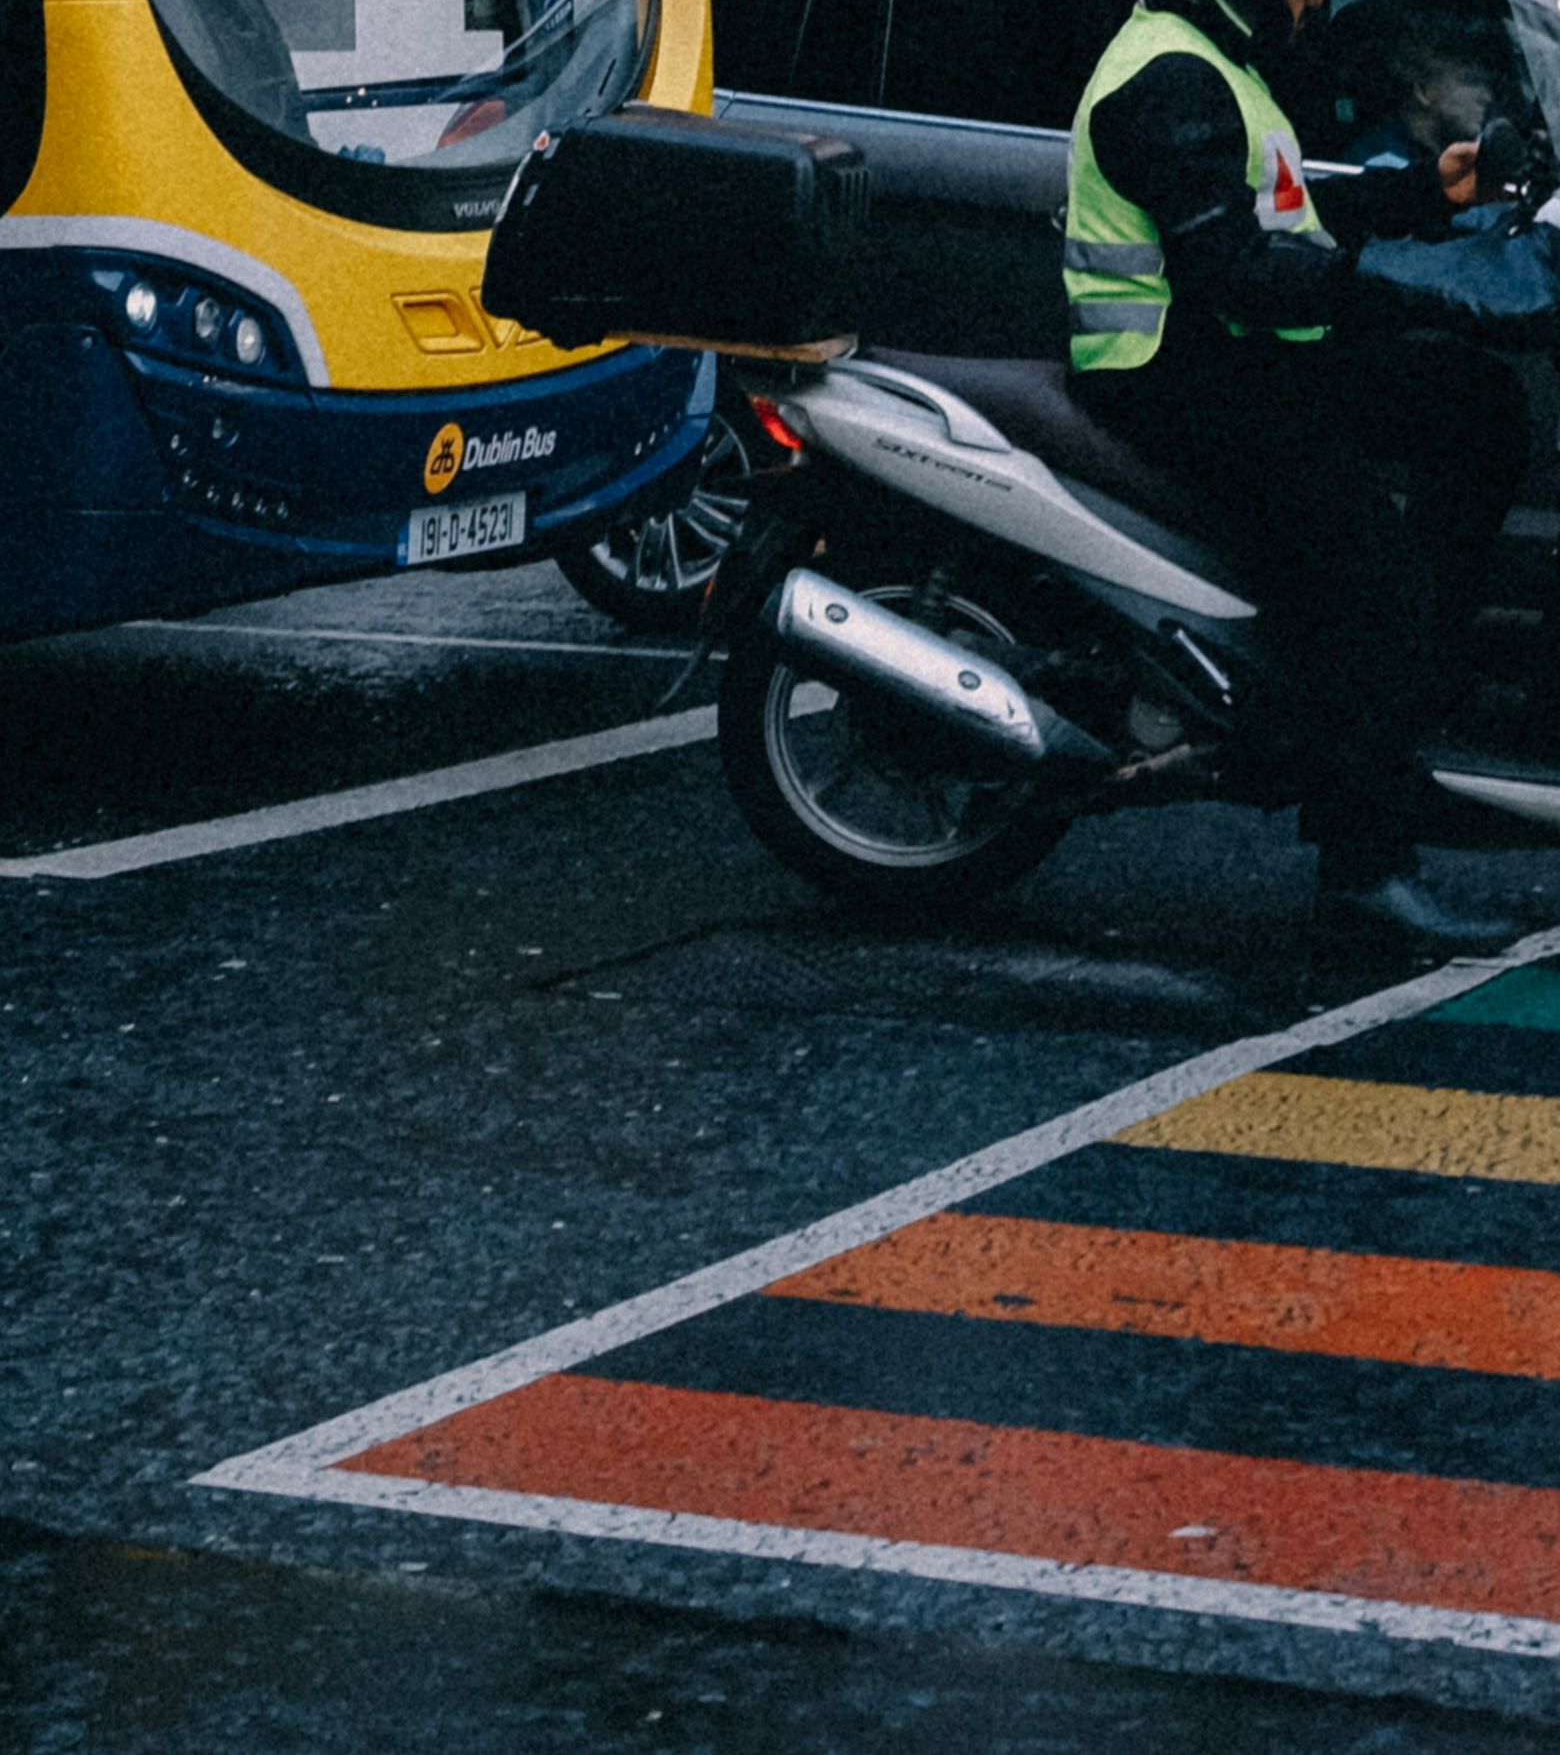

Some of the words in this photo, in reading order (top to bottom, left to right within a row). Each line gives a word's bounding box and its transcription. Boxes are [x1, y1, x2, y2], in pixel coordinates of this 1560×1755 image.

[462, 432, 521, 472] Dublin
[521, 426, 556, 461] Bus
[420, 501, 513, 558] 191-D-45231
